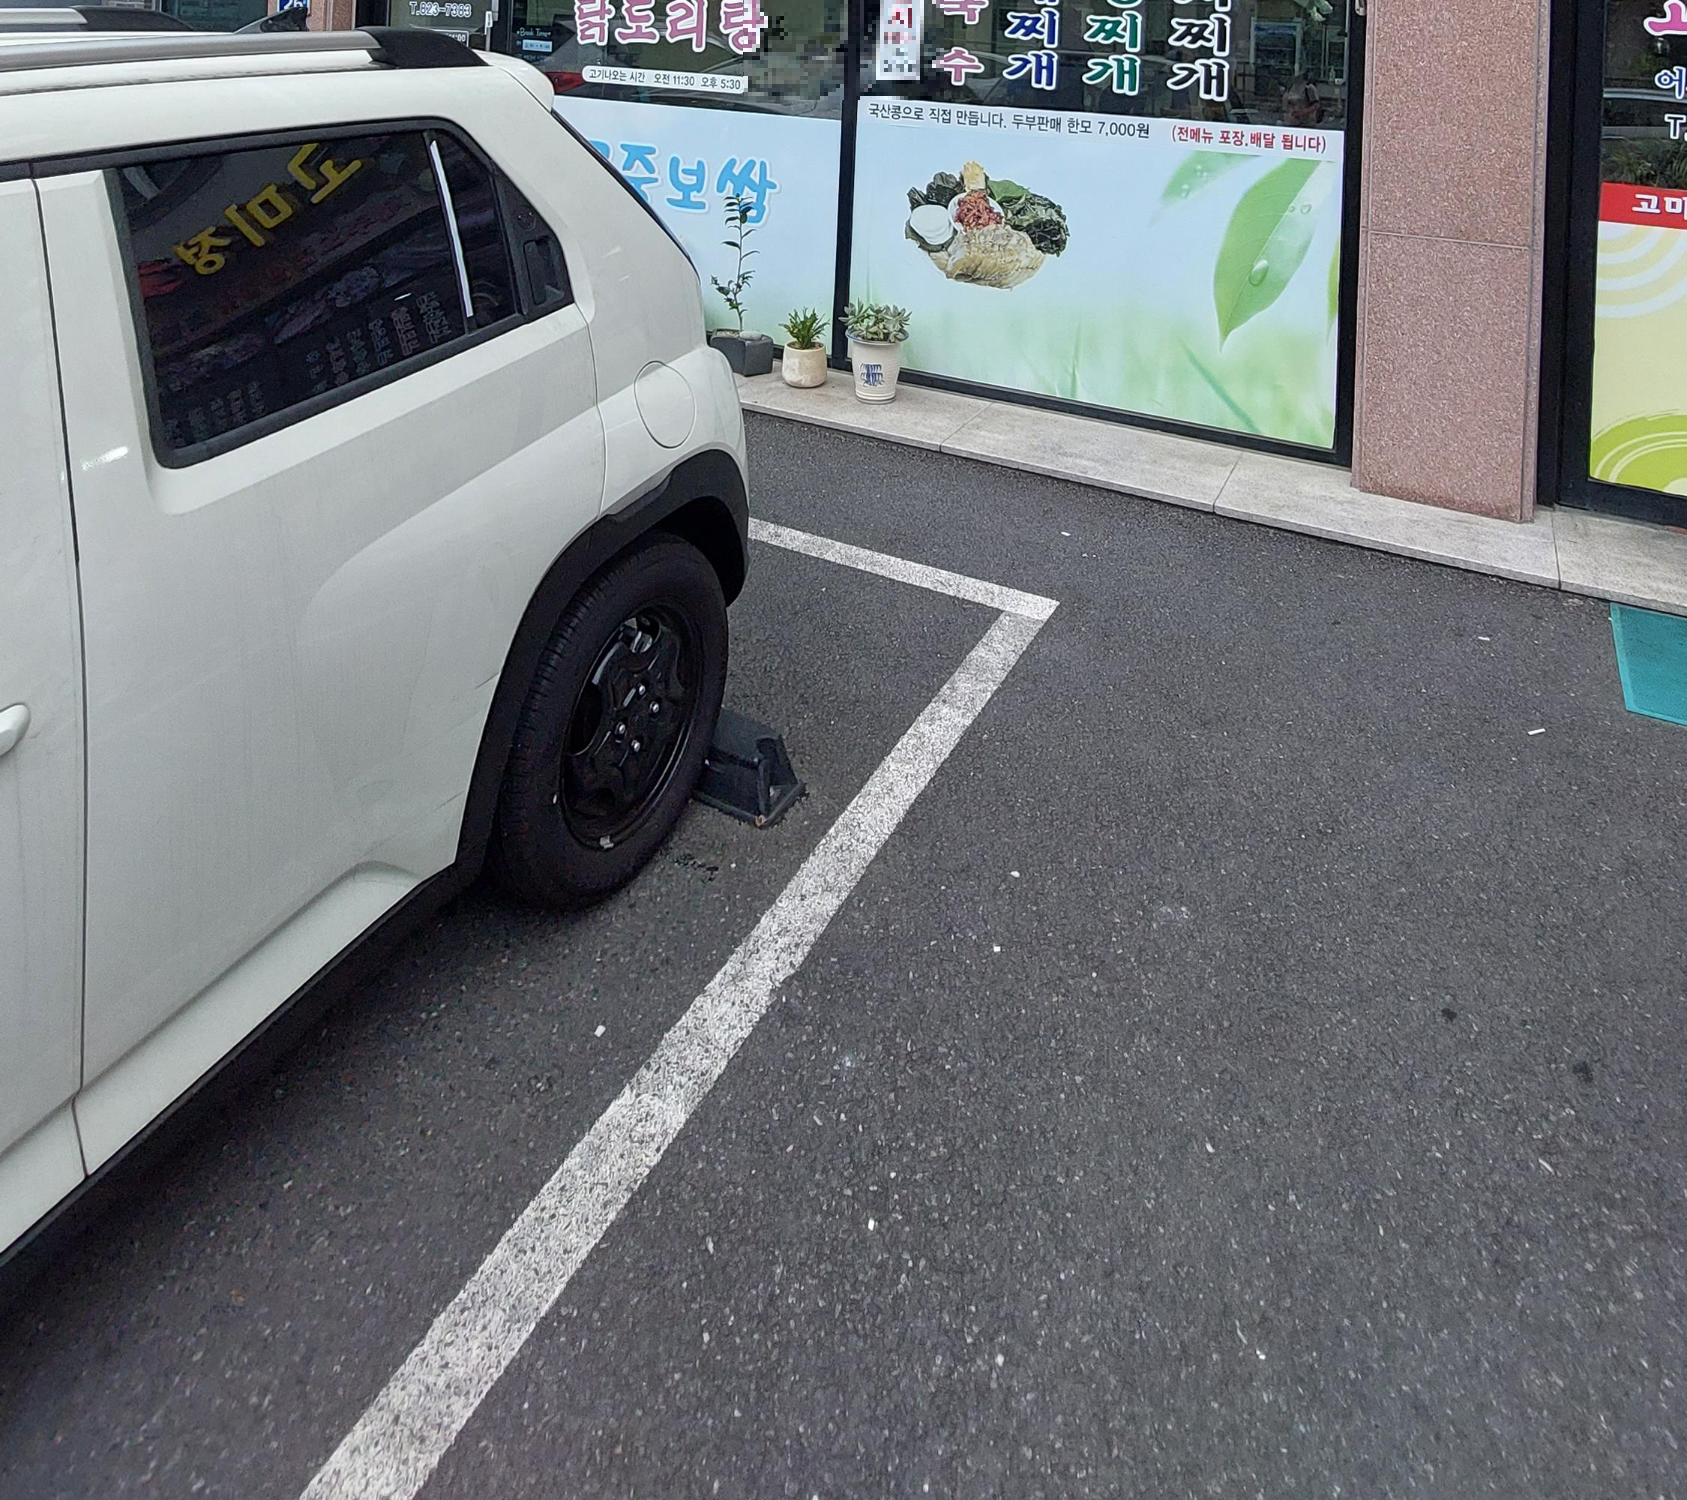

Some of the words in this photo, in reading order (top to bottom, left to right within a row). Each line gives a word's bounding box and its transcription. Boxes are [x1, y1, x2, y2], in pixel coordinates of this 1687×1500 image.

[588, 69, 627, 82] 고기나오는
[629, 72, 646, 83] 시간
[653, 73, 671, 85] 오전
[673, 76, 695, 87] 11:30
[700, 77, 718, 89] 오후
[720, 79, 741, 90] 5:30
[868, 103, 924, 121] 국산콩으로
[928, 107, 951, 124] 직접
[956, 109, 1007, 129] 만듭니다.
[1012, 114, 1062, 132] 두부판매
[1067, 118, 1093, 134] 한모
[1097, 121, 1150, 139] 7,000원
[1171, 124, 1214, 145] (전메뉴
[1281, 134, 1327, 153] 됩니다)
